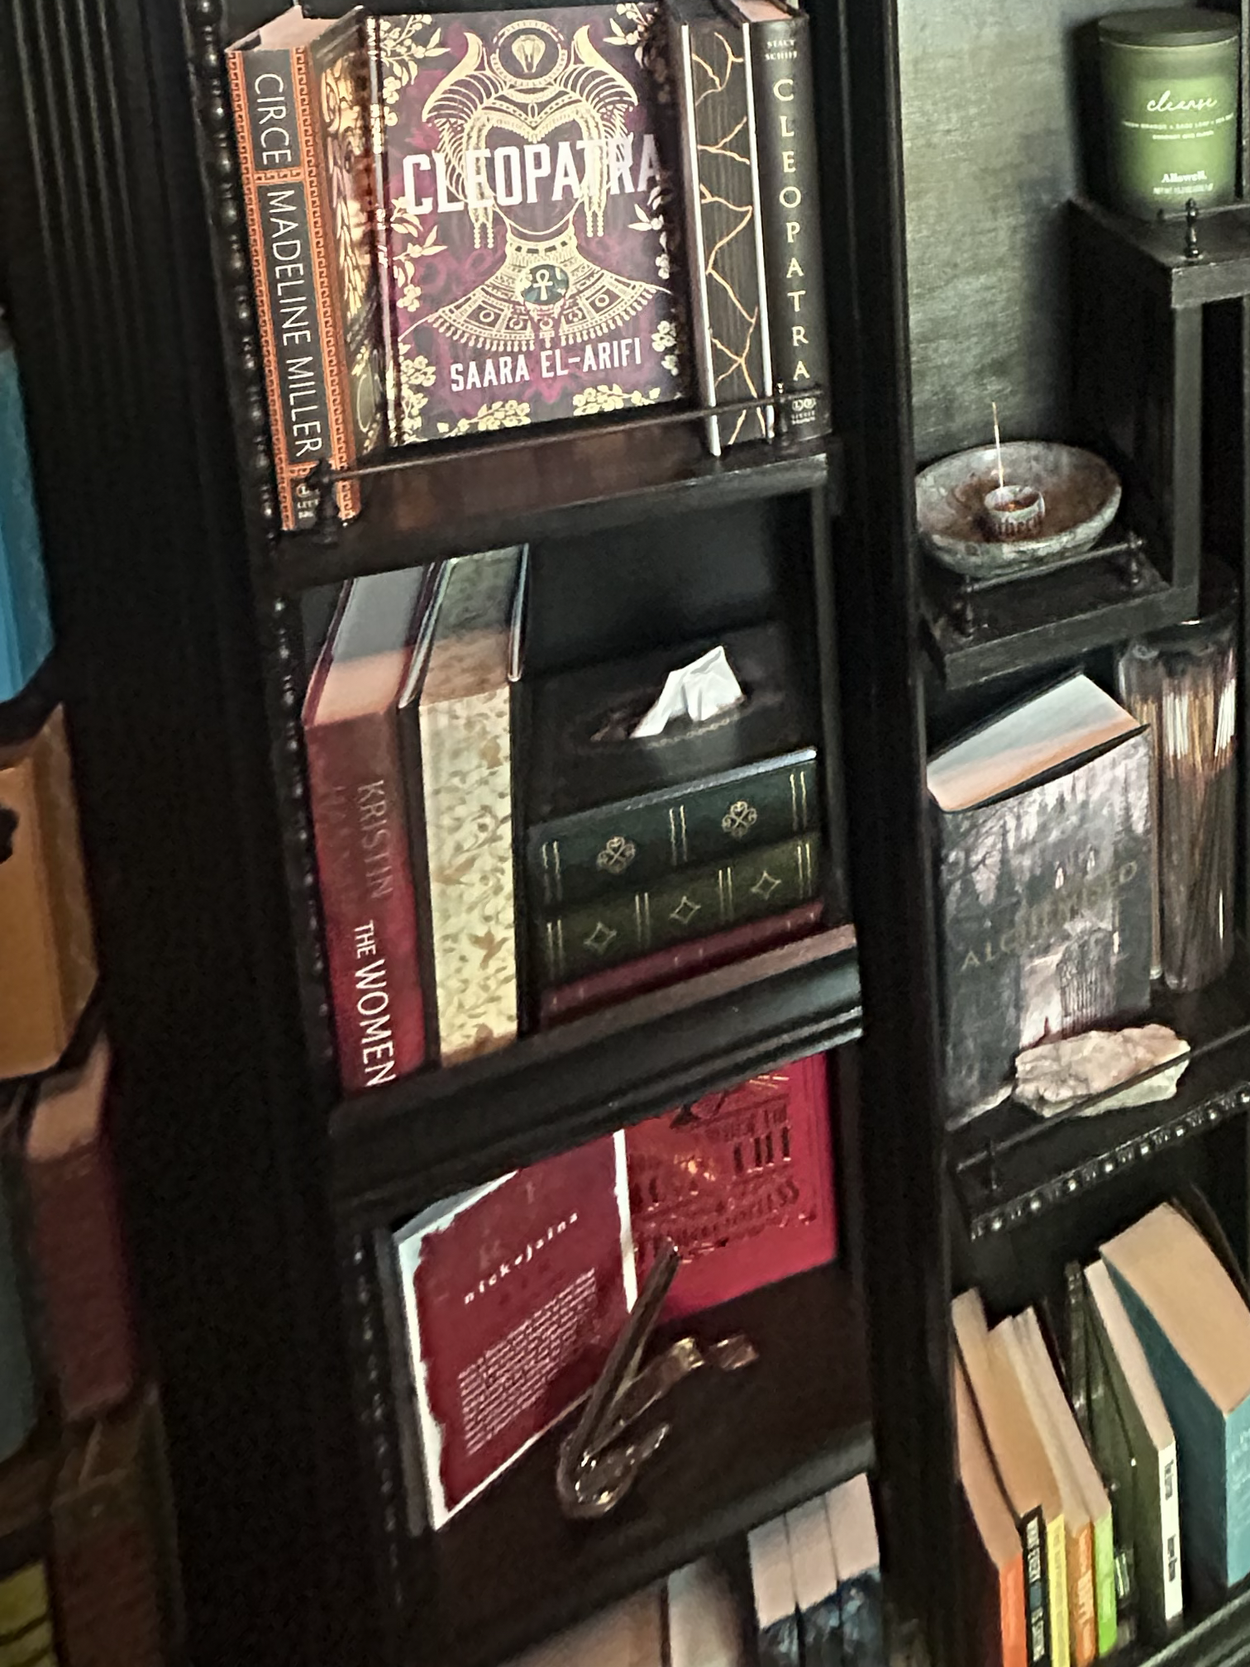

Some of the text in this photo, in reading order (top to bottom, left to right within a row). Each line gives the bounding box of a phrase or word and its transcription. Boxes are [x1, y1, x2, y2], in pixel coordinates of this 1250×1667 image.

[254, 72, 292, 169] CIRCE
[1147, 90, 1217, 113] cleanse
[403, 134, 662, 216] CLEOPATRA
[773, 78, 811, 381] CLEOPATRA
[266, 189, 323, 460] MADELINE MILLER
[450, 341, 643, 394] SAARA EL-ARIFI
[357, 780, 394, 900] KRISTIN
[354, 920, 397, 1089] THE WOMEN
